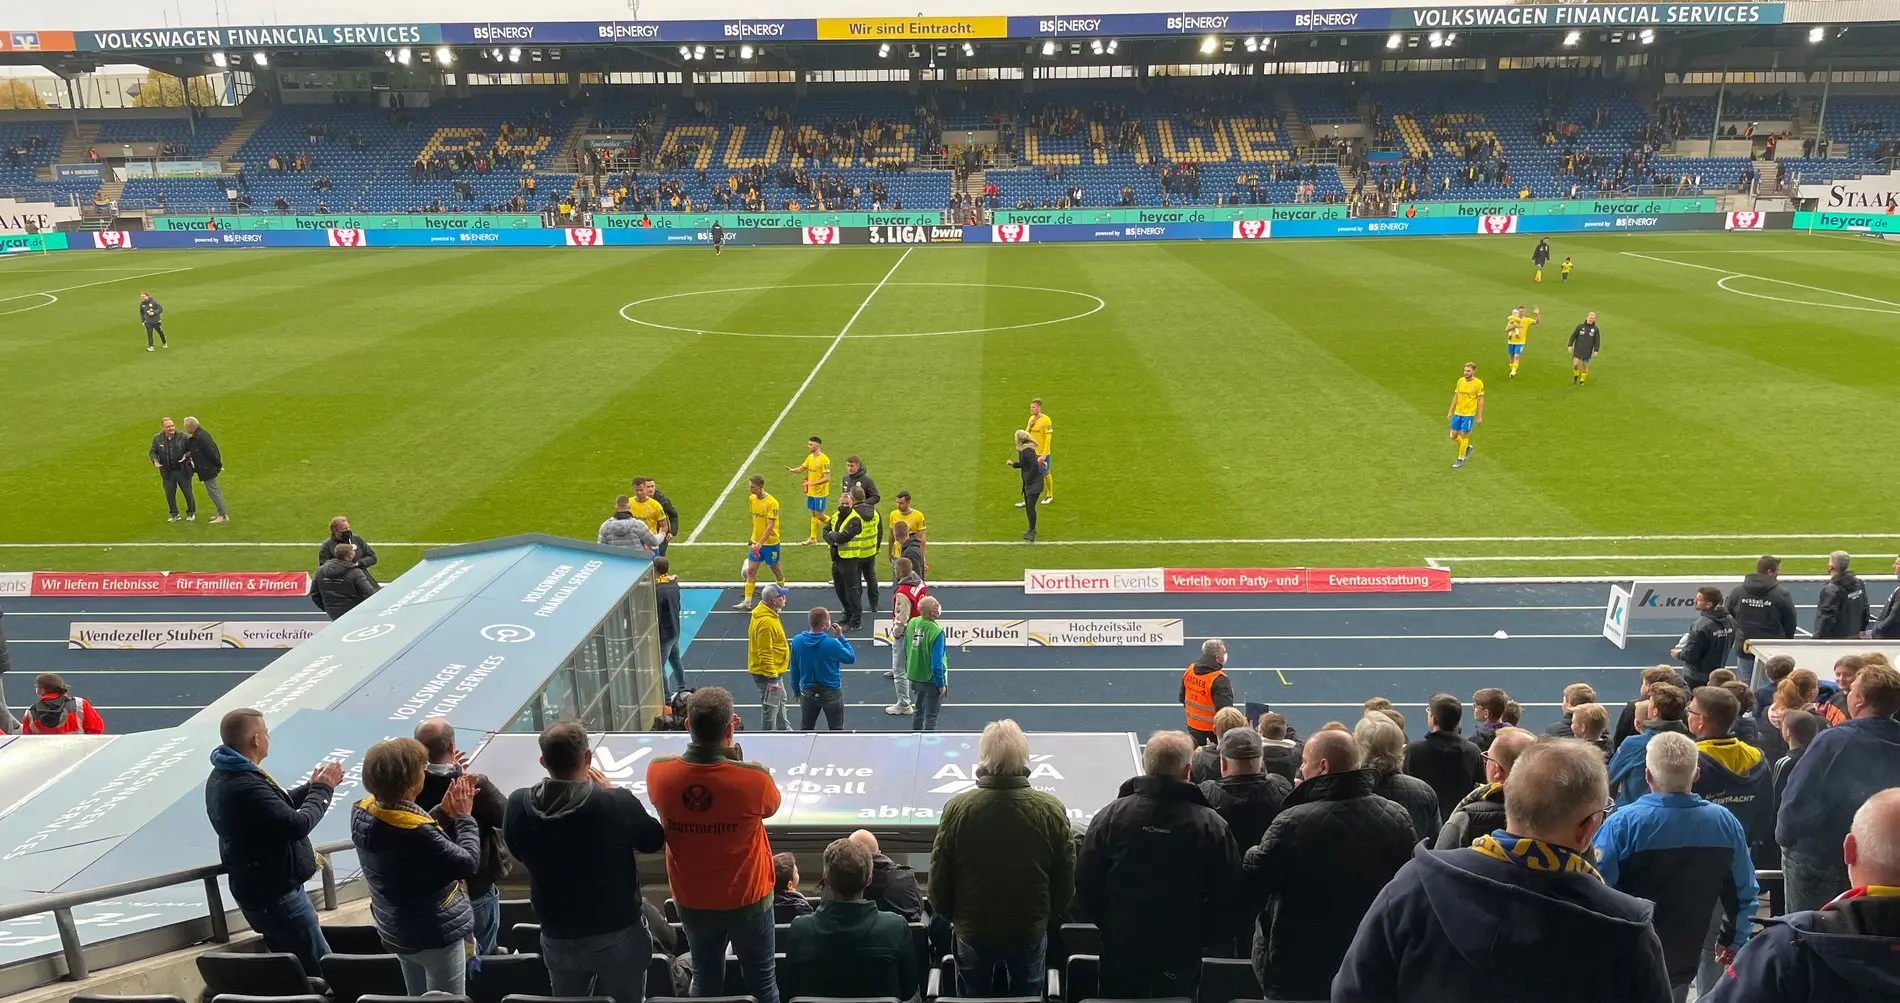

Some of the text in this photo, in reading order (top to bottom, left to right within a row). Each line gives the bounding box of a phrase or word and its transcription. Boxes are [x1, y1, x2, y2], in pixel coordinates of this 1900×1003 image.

[1413, 5, 1760, 27] VOLKSWAGEN FINANCIAL SERVICES
[849, 22, 975, 35] Wir sind Eintracht.
[95, 26, 421, 50] VOLKSWAGEN FINANCIAL SERVICES
[1828, 185, 1900, 208] STAAK
[0, 214, 50, 229] AAKE
[930, 226, 963, 238] bwin
[0, 580, 26, 592] ents
[41, 579, 160, 591] Wir liefern Erlebnisse
[176, 578, 298, 591] für Familien & Firmen
[1030, 574, 1159, 589] Northern Events
[1172, 575, 1299, 589] Verleih von Party- und
[1328, 574, 1429, 589] Eventausstattung
[972, 627, 1019, 639] Stuben
[1069, 622, 1142, 632] Hochzeitssäle
[79, 629, 214, 642] Wendezeller Stuben
[243, 629, 314, 640] Servicekräfte
[1048, 633, 1164, 647] in Wendeburg und BS
[388, 663, 467, 720] VOLKSWAGEN
[420, 655, 505, 723] NCIAL SERVICES
[787, 762, 874, 777] drive
